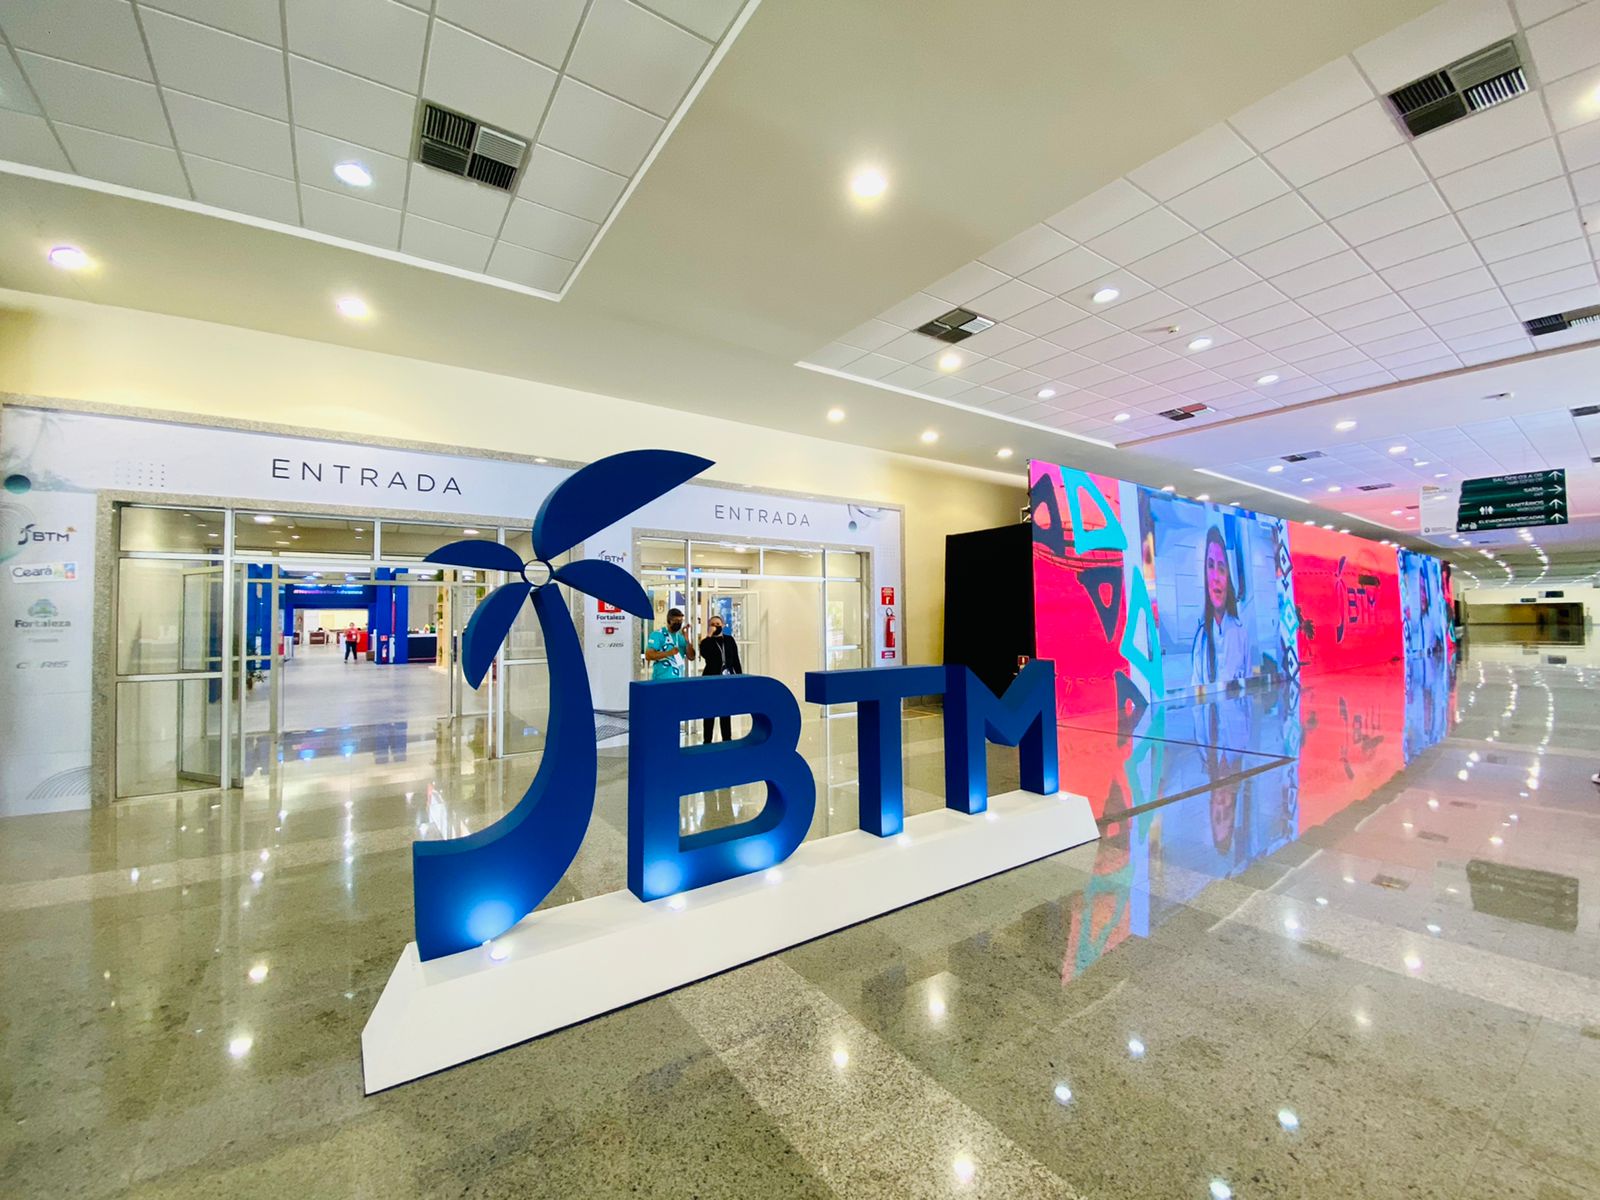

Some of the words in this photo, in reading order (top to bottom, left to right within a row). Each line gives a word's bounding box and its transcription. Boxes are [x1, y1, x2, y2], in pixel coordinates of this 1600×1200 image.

[271, 458, 463, 496] ENTRADA
[714, 504, 811, 528] ENTRADA
[33, 531, 70, 542] BTM
[604, 555, 624, 563] BTM
[12, 565, 53, 578] Ceará
[14, 619, 72, 628] Fortaleza
[628, 659, 1061, 903] BTM
